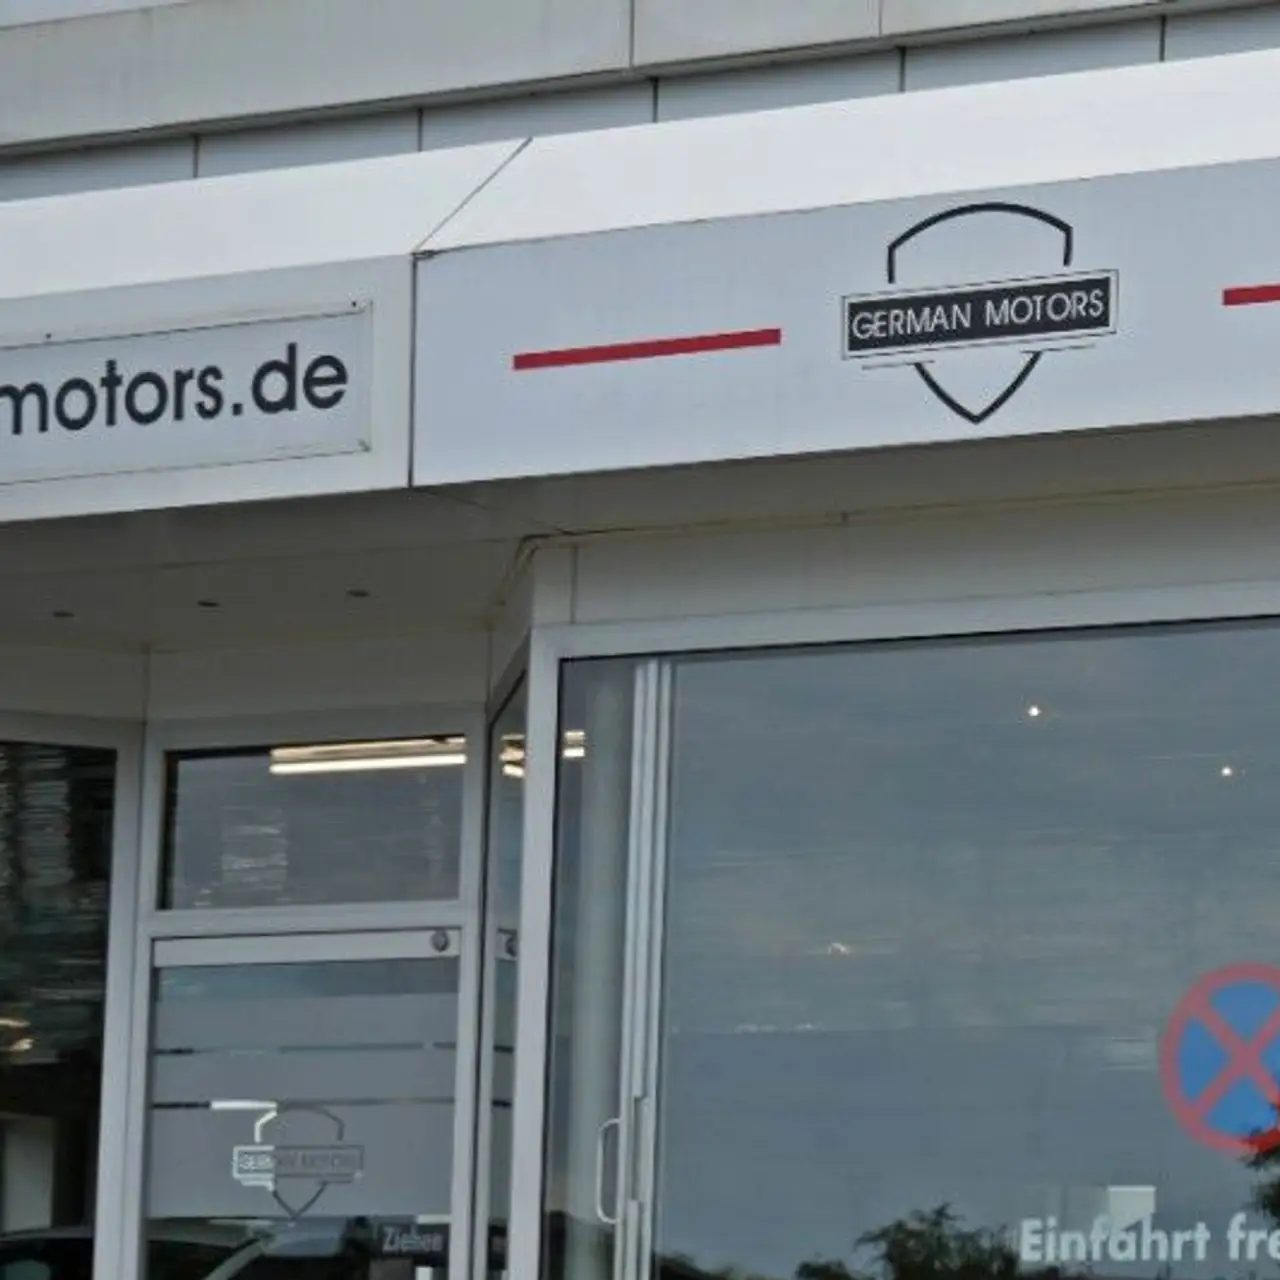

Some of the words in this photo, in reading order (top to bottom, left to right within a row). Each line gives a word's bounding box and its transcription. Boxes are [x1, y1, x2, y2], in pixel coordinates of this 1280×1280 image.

[852, 302, 972, 340] GERMAN
[985, 289, 1104, 326] MOTORS
[1019, 1213, 1211, 1262] Einfahrt
